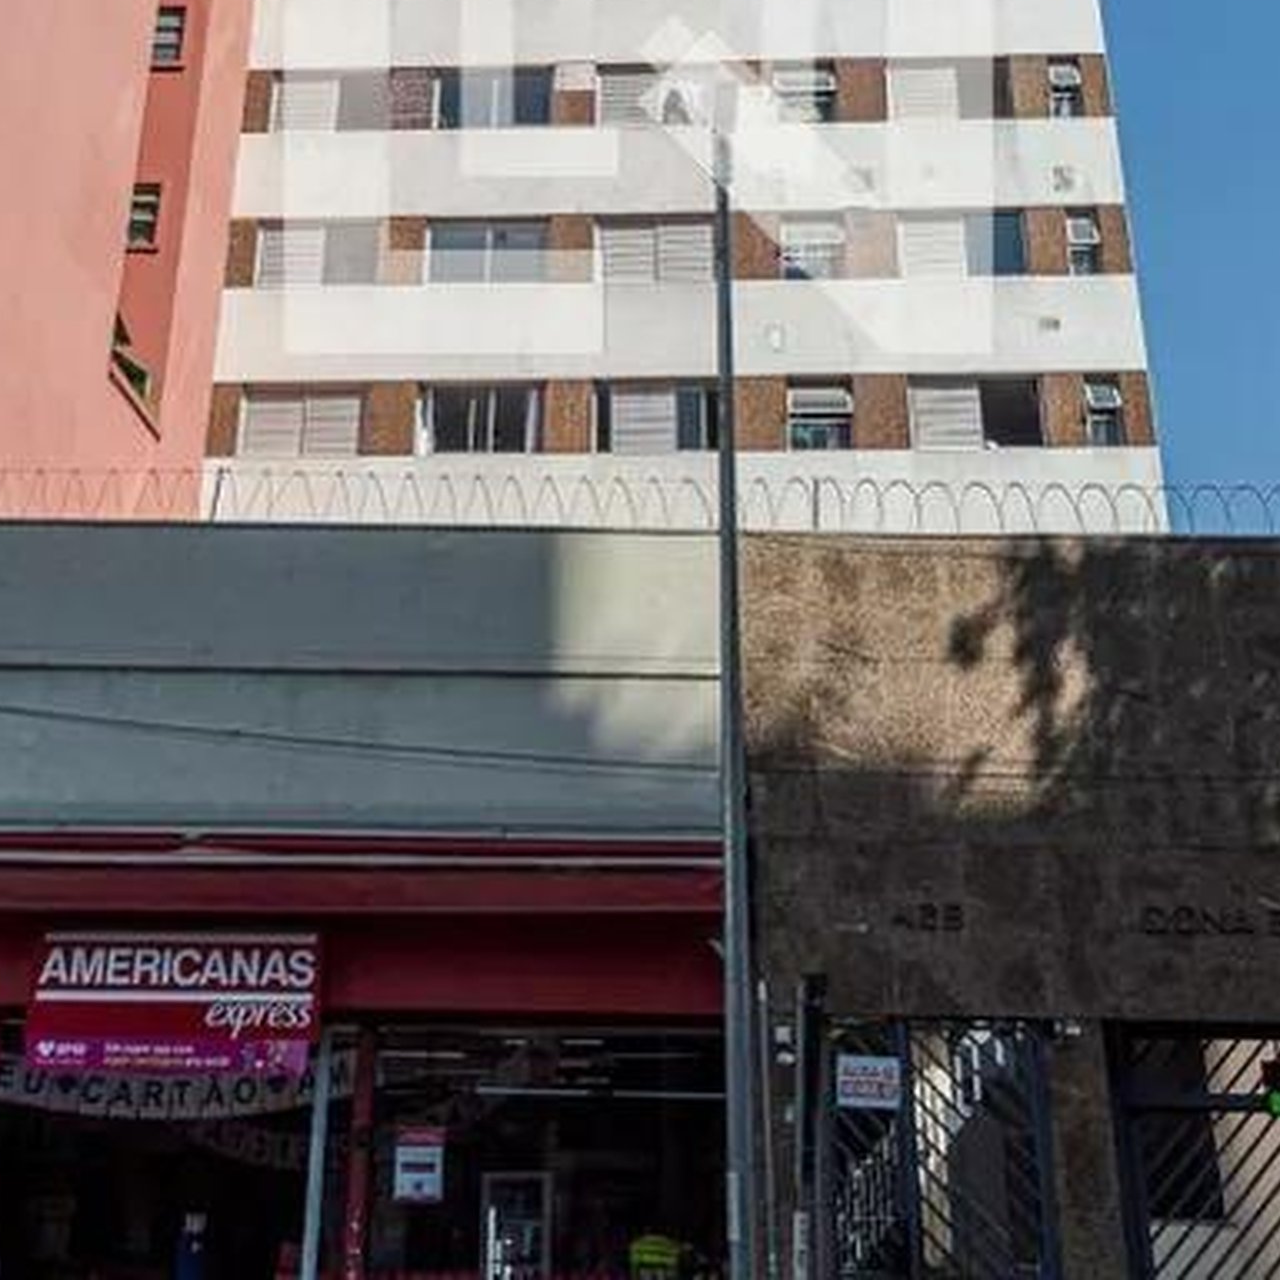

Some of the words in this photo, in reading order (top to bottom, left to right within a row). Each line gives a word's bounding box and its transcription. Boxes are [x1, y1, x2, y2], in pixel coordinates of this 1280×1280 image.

[38, 947, 316, 987] AMERICANAS
[205, 1001, 312, 1040] express
[81, 1071, 257, 1108] CARTÃO
